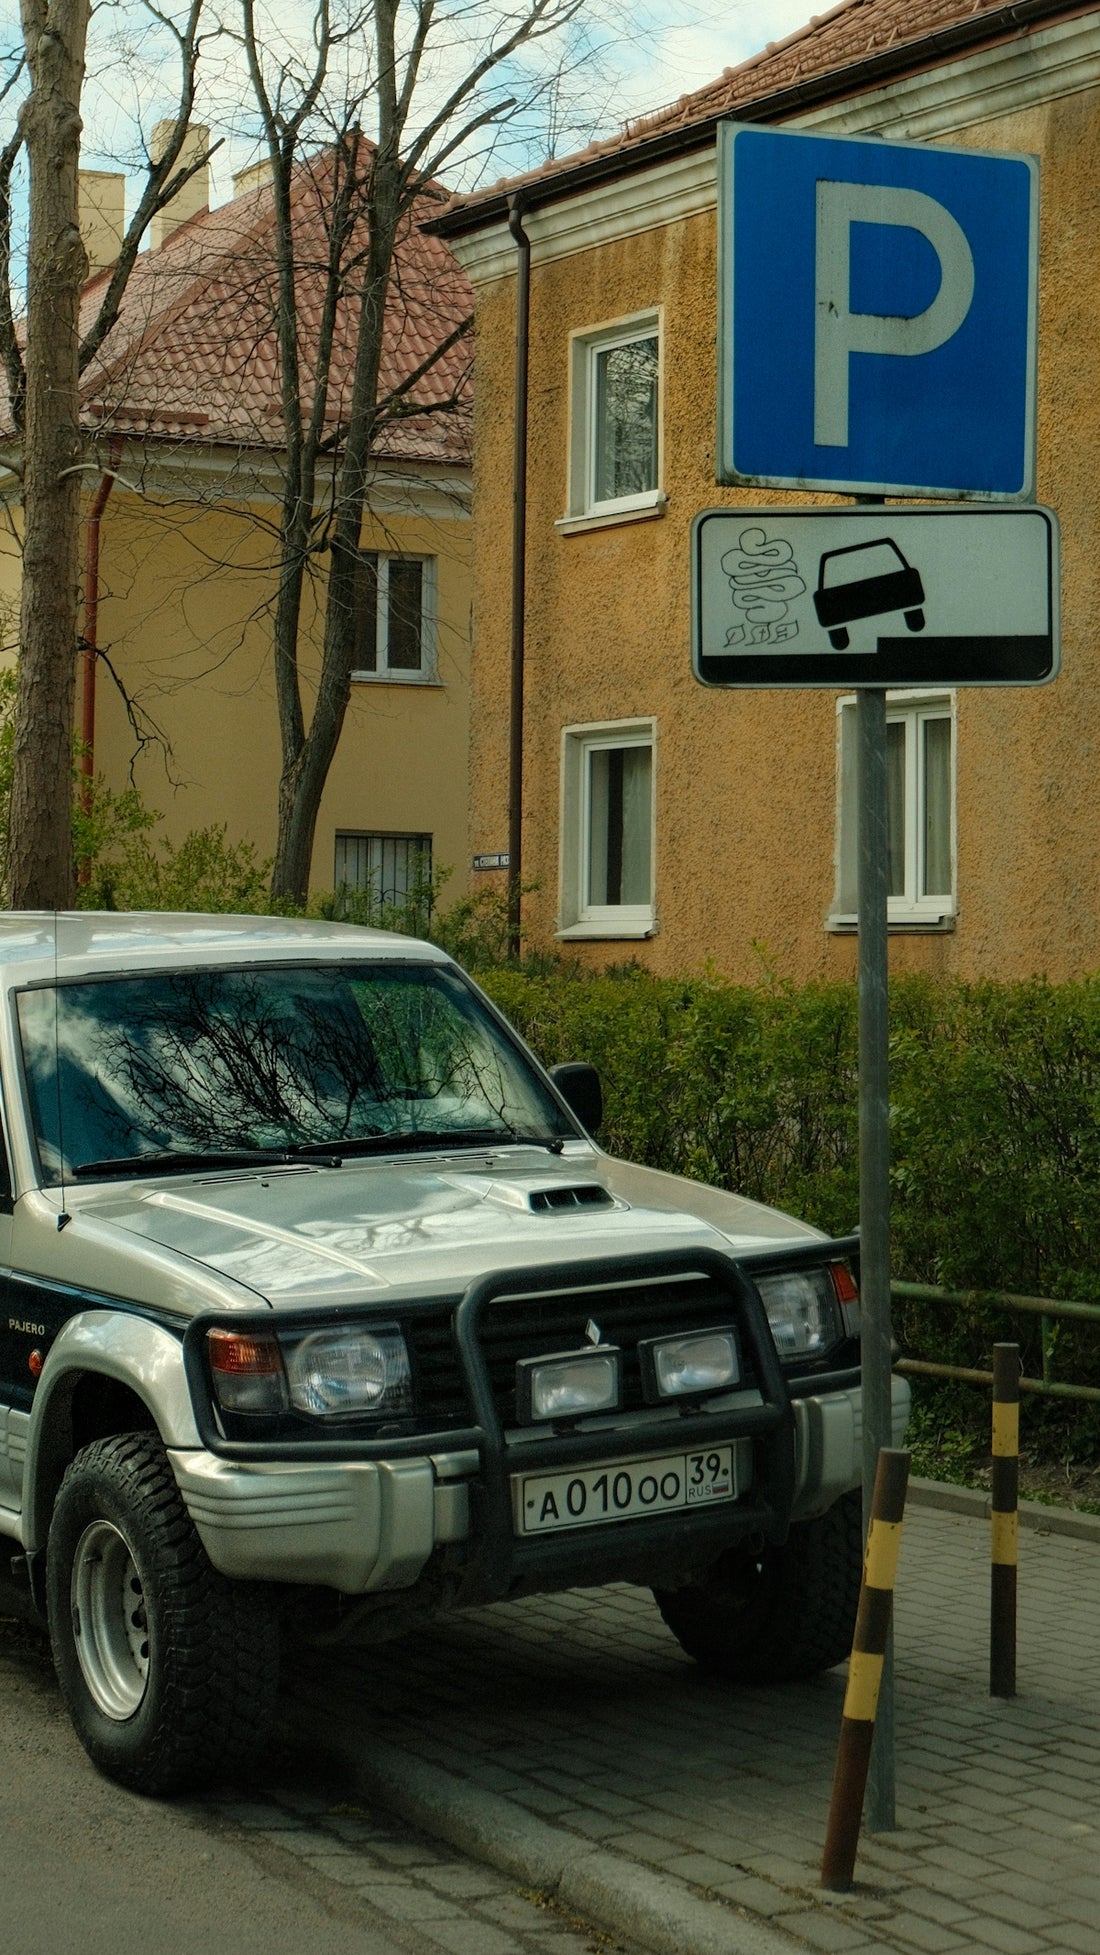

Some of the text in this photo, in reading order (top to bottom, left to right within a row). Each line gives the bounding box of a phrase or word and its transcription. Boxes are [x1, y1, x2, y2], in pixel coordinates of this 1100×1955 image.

[814, 178, 975, 447] P
[8, 1318, 45, 1336] PAJERO
[690, 1453, 721, 1485] 39
[688, 1485, 712, 1498] RUS
